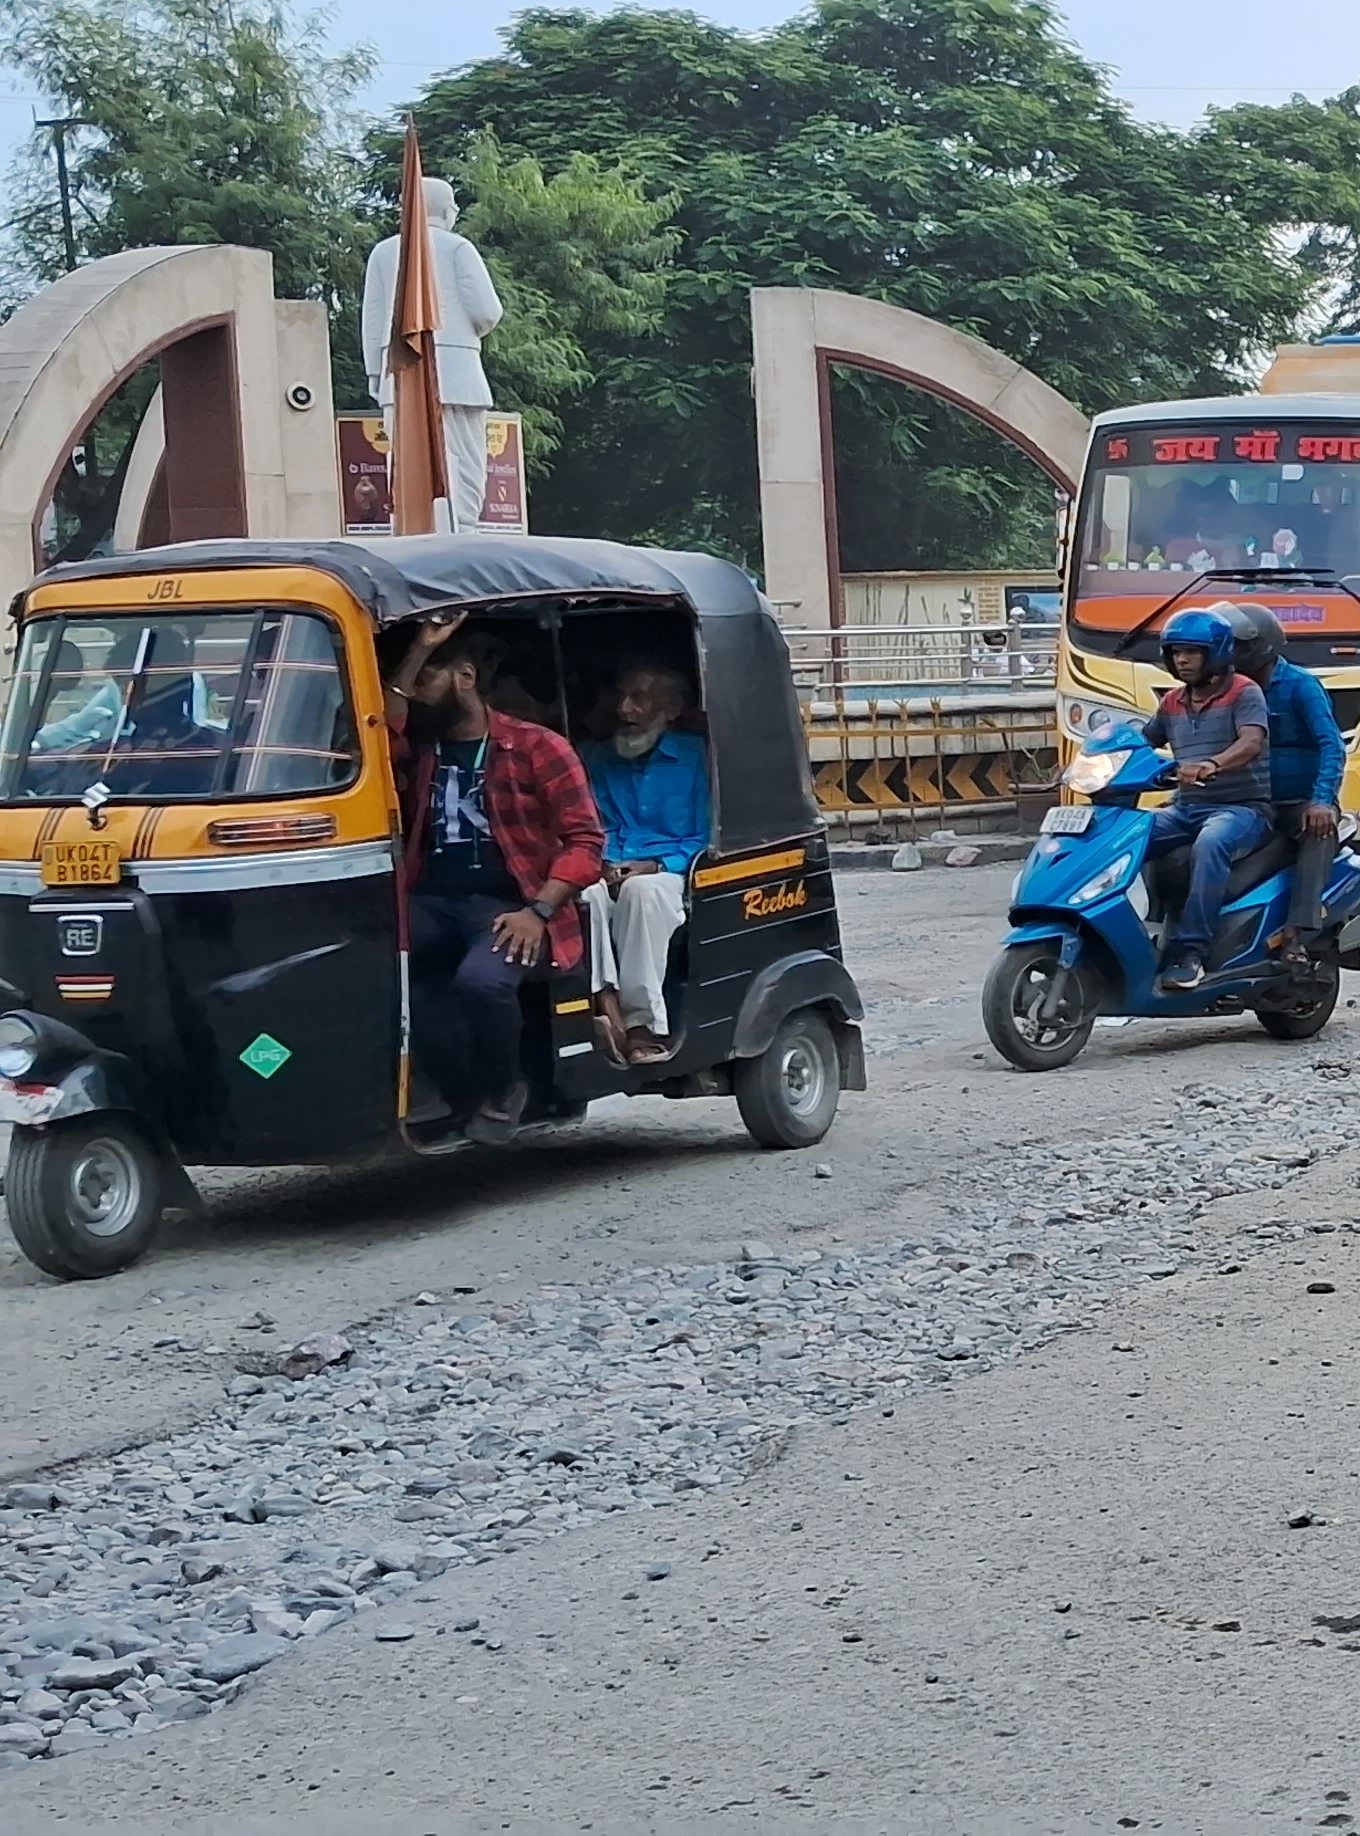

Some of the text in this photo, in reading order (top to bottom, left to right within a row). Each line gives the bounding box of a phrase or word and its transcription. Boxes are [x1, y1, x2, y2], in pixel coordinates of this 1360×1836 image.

[1153, 436, 1220, 461] जय
[147, 580, 183, 599] JBL
[55, 844, 112, 863] UK04T
[58, 864, 112, 882] B1864
[743, 880, 808, 920] Reebok
[66, 927, 95, 947] RE
